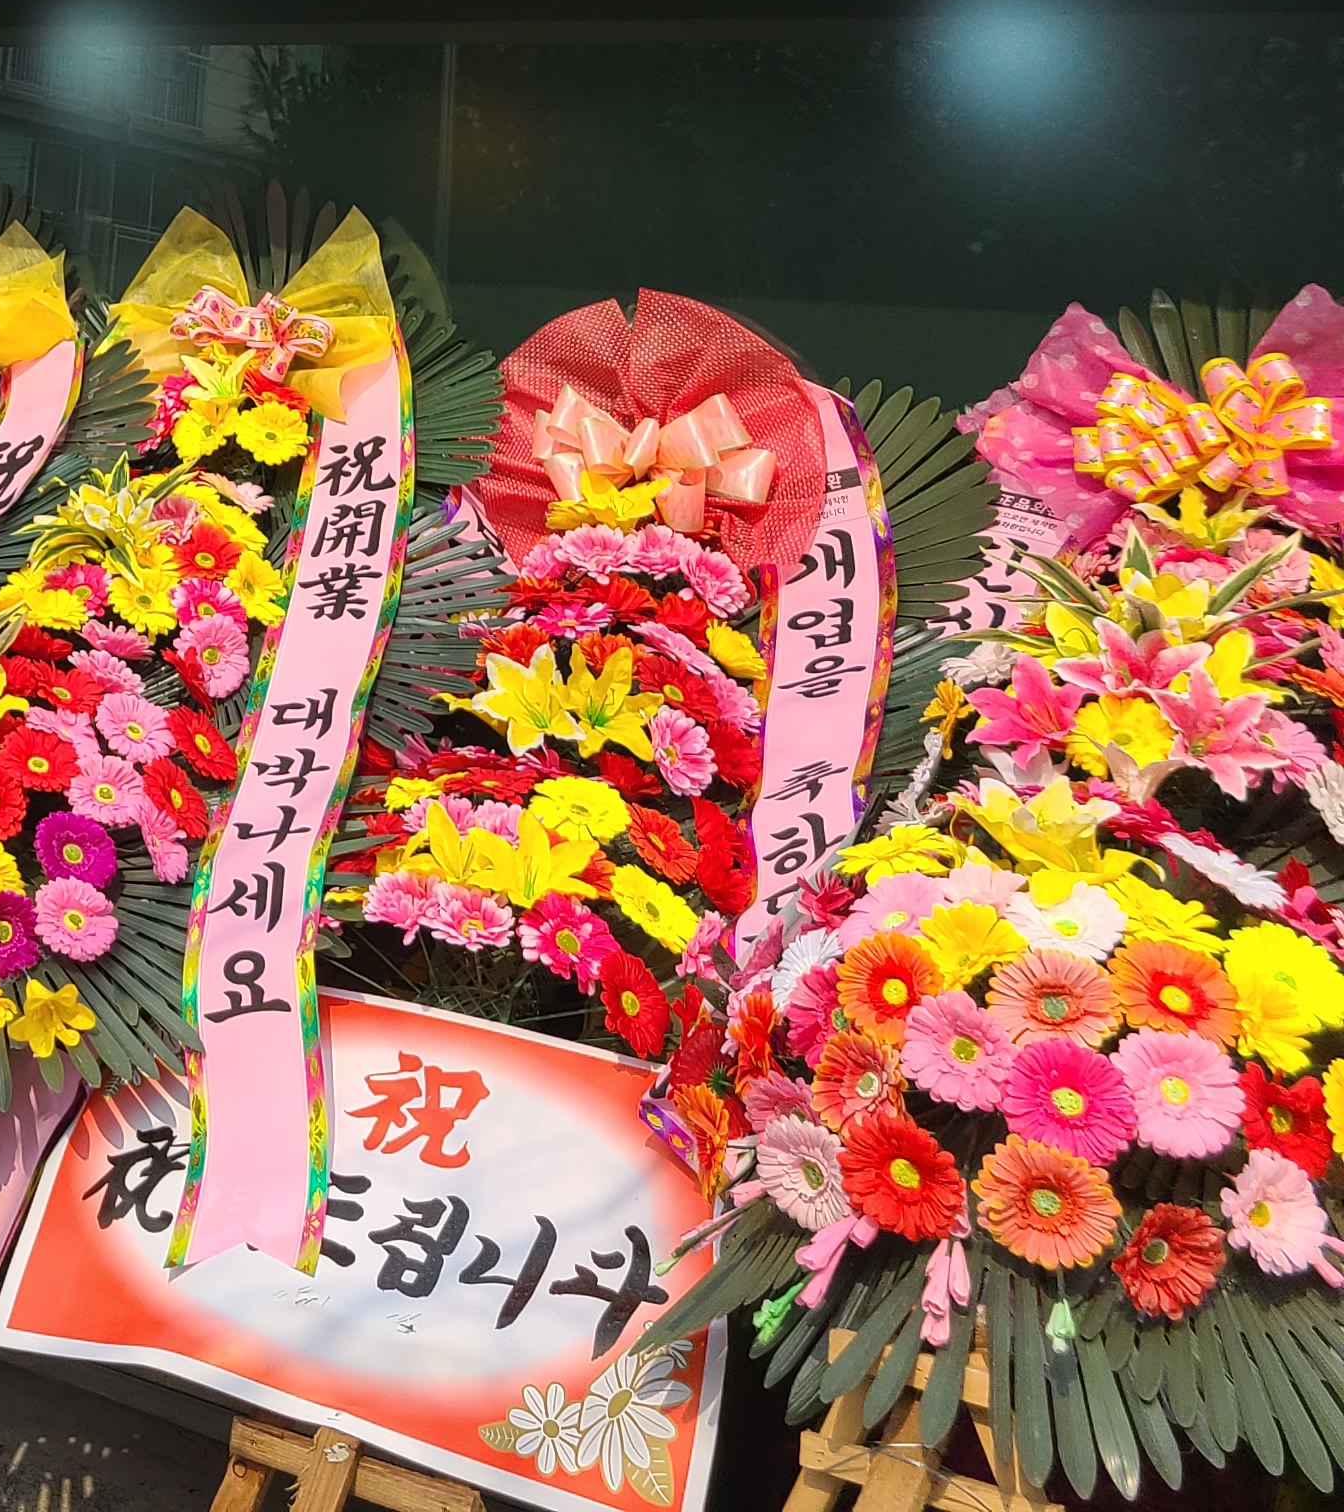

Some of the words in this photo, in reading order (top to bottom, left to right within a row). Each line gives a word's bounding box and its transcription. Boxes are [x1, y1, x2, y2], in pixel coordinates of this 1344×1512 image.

[298, 436, 397, 622] 祝開業
[777, 528, 867, 699] 개업을
[205, 687, 334, 1023] 대박나세요
[344, 1050, 491, 1170] 祝
